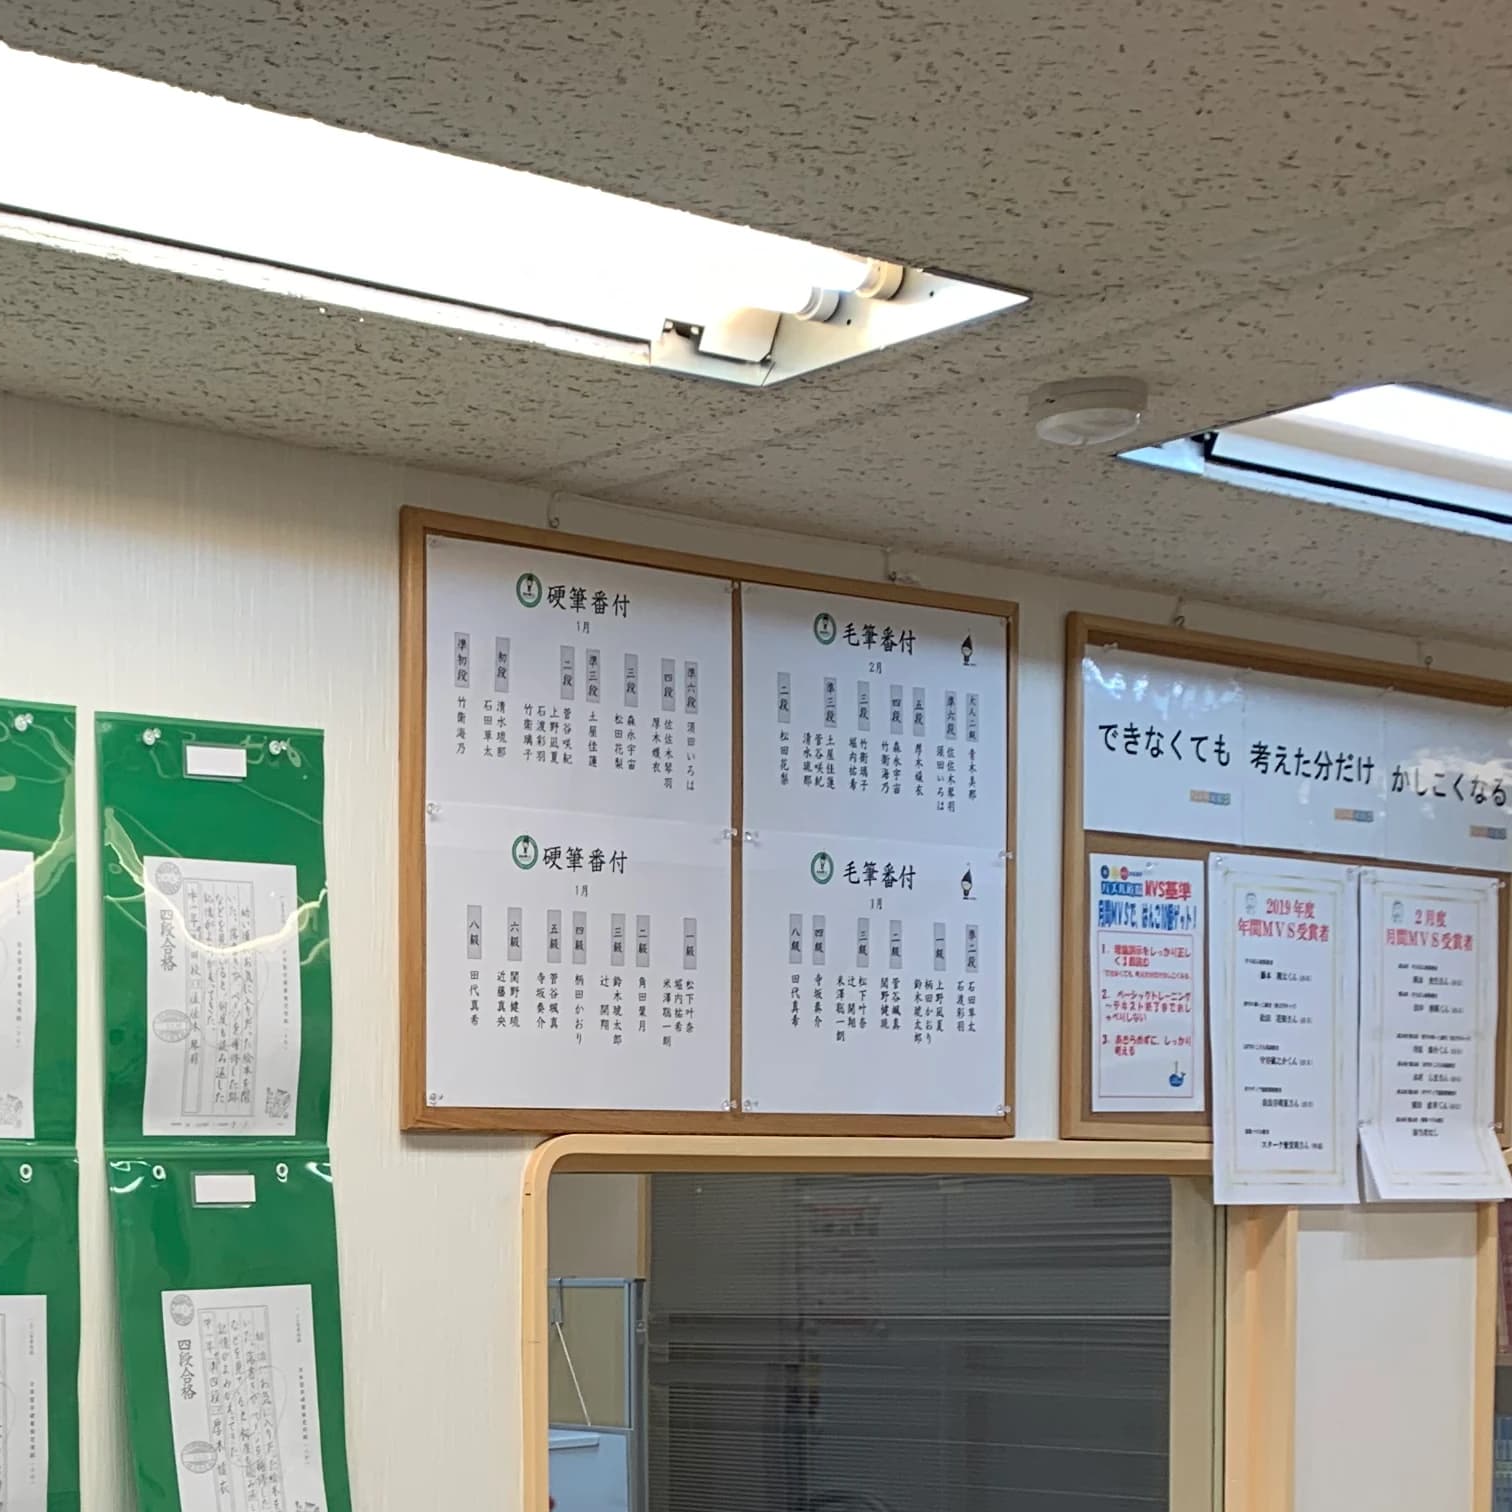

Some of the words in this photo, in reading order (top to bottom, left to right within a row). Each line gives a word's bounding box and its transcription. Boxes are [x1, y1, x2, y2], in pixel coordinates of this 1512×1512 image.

[547, 585, 631, 618] 硬筆番付
[843, 623, 916, 655] 毛筆番付
[497, 650, 508, 680] 初段
[562, 660, 573, 687] 二段
[869, 662, 882, 674] 2月
[626, 668, 636, 695] 三段
[663, 673, 674, 698] 四段
[779, 686, 789, 711] 二段
[891, 698, 902, 723] 四段
[914, 701, 924, 726] 五段
[1098, 722, 1231, 767] できなくても
[1250, 740, 1375, 784] 考えた分だけ
[1391, 765, 1507, 807] かしこくなる
[542, 845, 628, 875] 硬筆番付
[843, 860, 916, 891] 毛筆番付
[1266, 898, 1292, 915] 2019
[1294, 901, 1316, 920] 年度
[160, 909, 177, 971] 四段合格
[470, 920, 479, 946] 八級
[510, 921, 520, 948] 六級
[549, 925, 559, 950] 五級
[575, 927, 584, 951] 四級
[613, 928, 623, 953] 三級
[638, 929, 648, 954] 二級
[791, 928, 801, 952] 八級
[814, 928, 824, 953] 四級
[858, 931, 868, 956] 三級
[891, 933, 902, 958] 二級
[935, 937, 945, 960] 一級
[177, 1339, 197, 1400] 四段合格
